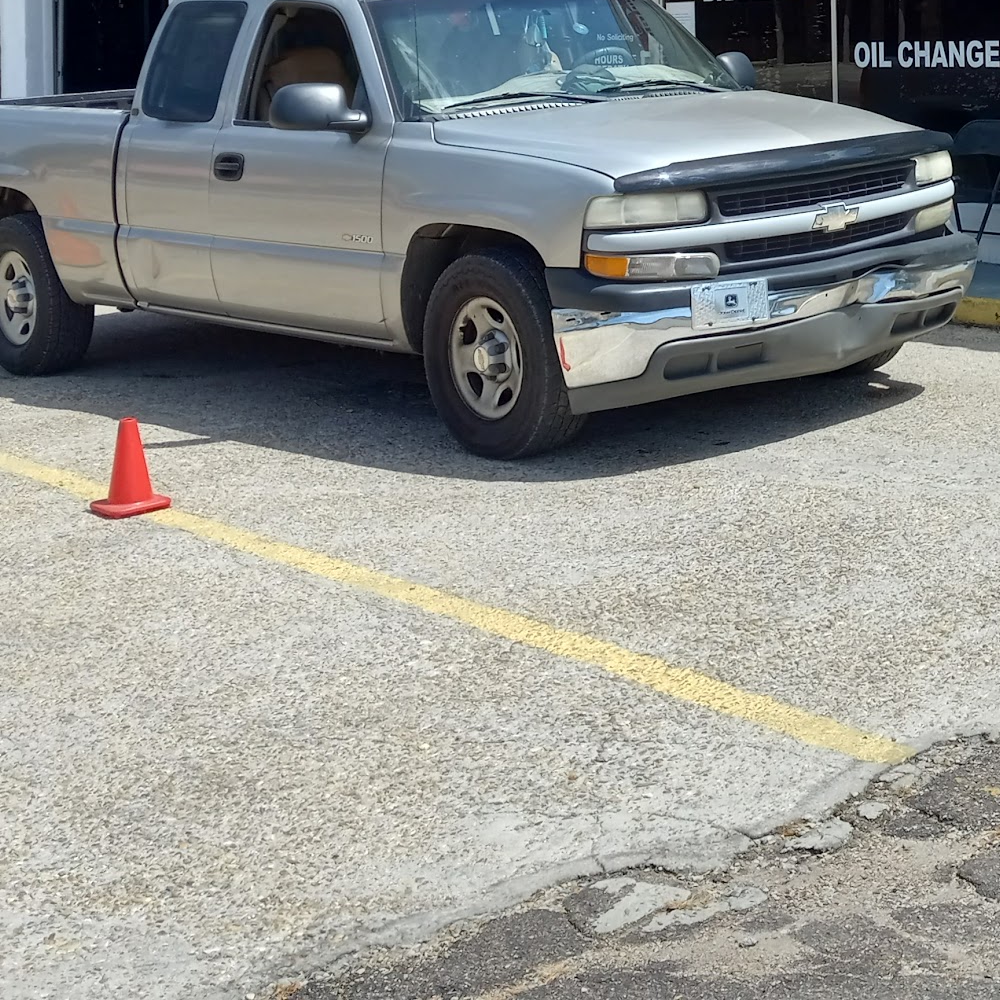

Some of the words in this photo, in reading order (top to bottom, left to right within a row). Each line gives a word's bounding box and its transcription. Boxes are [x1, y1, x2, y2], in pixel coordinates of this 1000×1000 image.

[608, 34, 634, 42] Soliciting
[595, 55, 624, 64] HOURS
[853, 41, 893, 69] OIL
[352, 234, 374, 244] 1500
